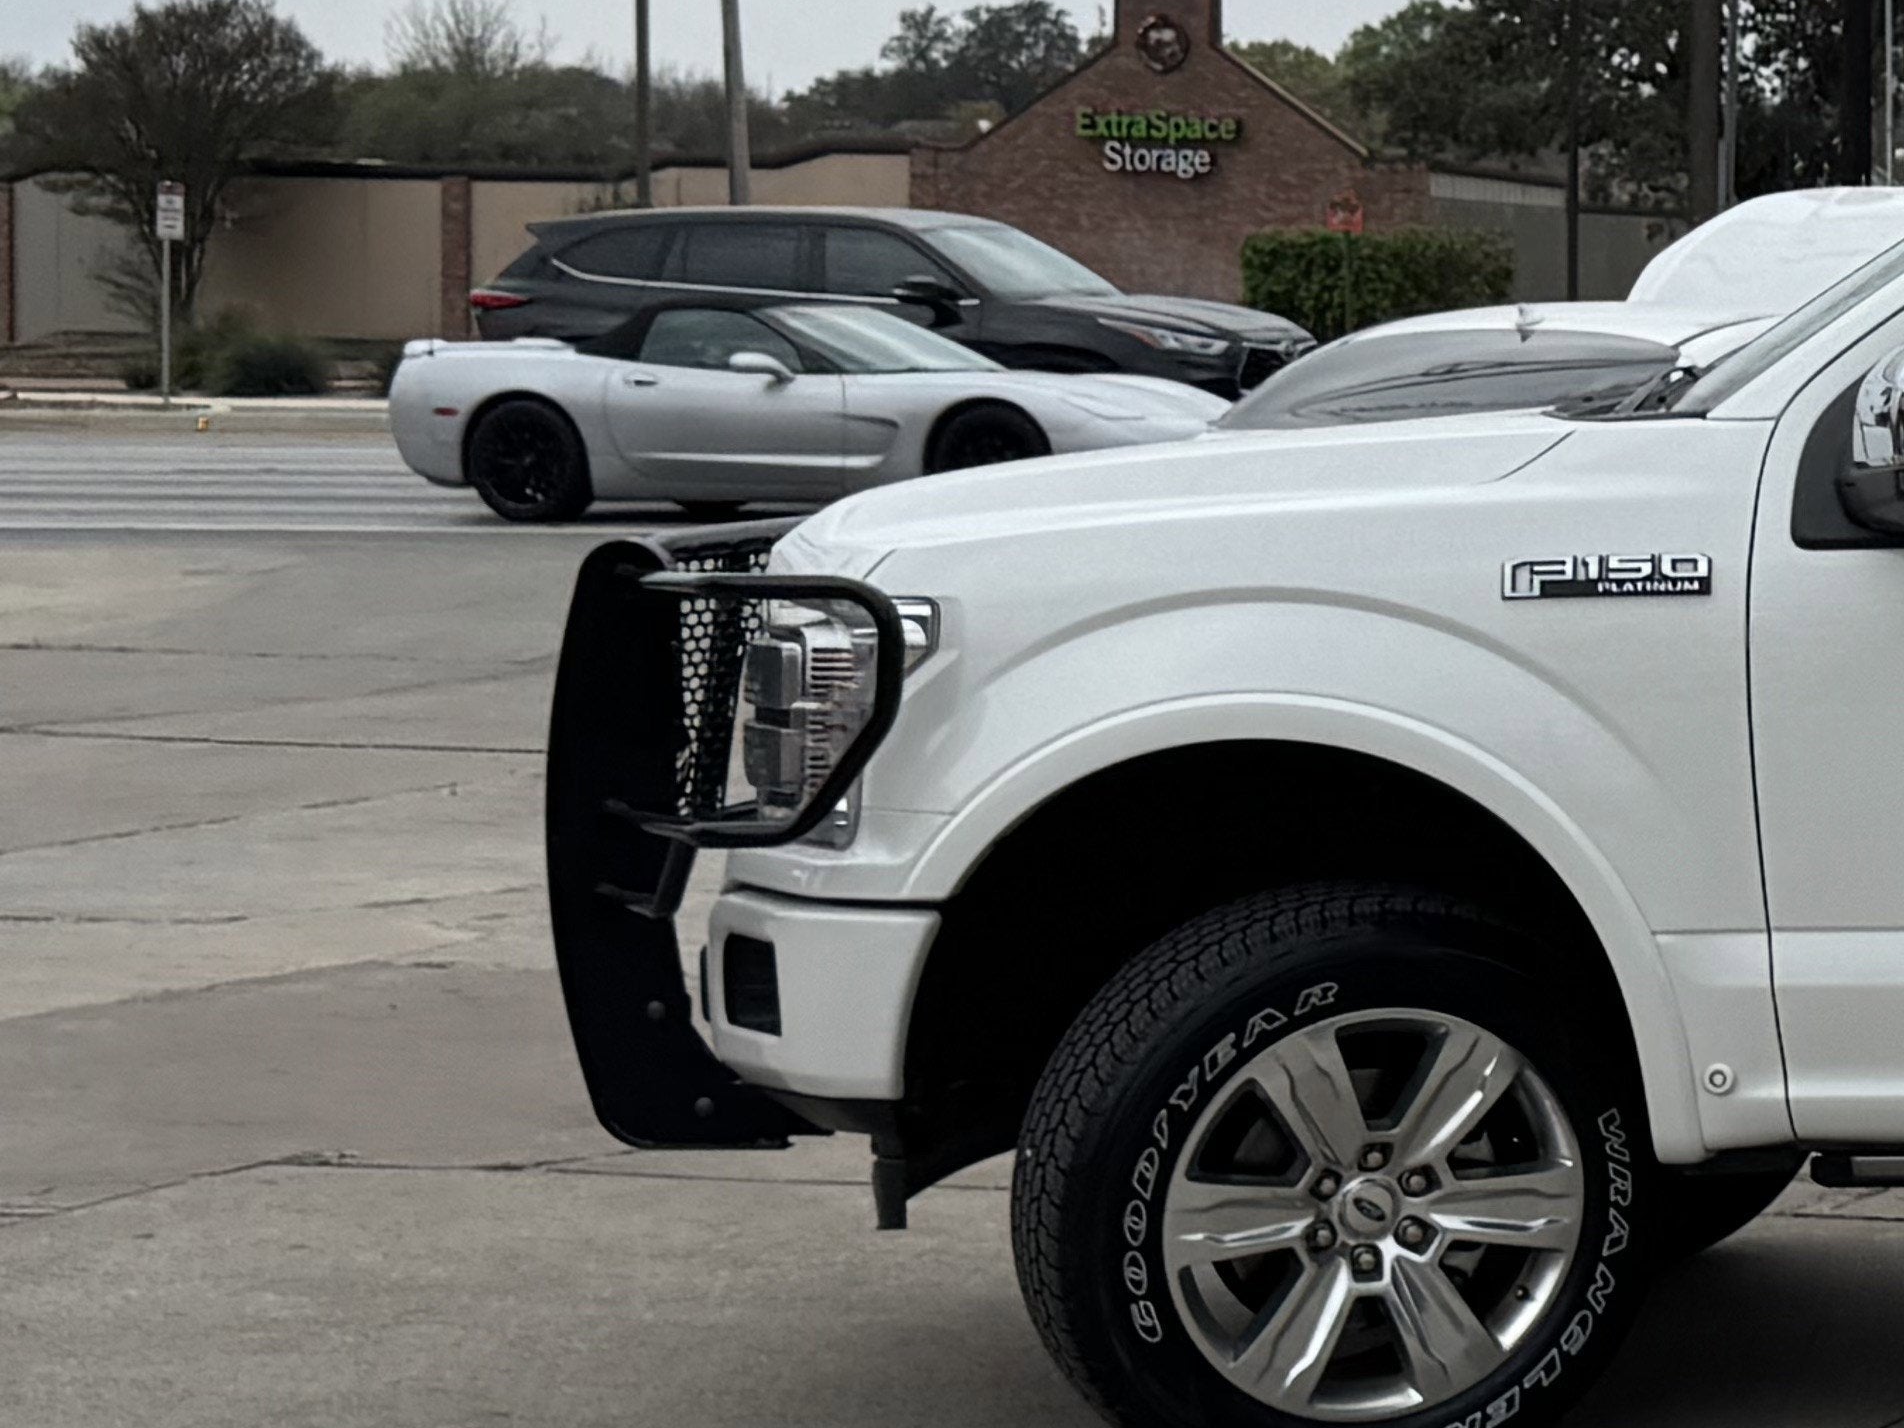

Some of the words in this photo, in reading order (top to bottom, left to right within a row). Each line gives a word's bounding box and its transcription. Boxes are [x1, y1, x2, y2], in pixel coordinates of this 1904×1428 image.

[1103, 139, 1213, 179] Storage
[1597, 578, 1701, 594] PLATINUM
[1122, 980, 1339, 1343] GOODYEAR
